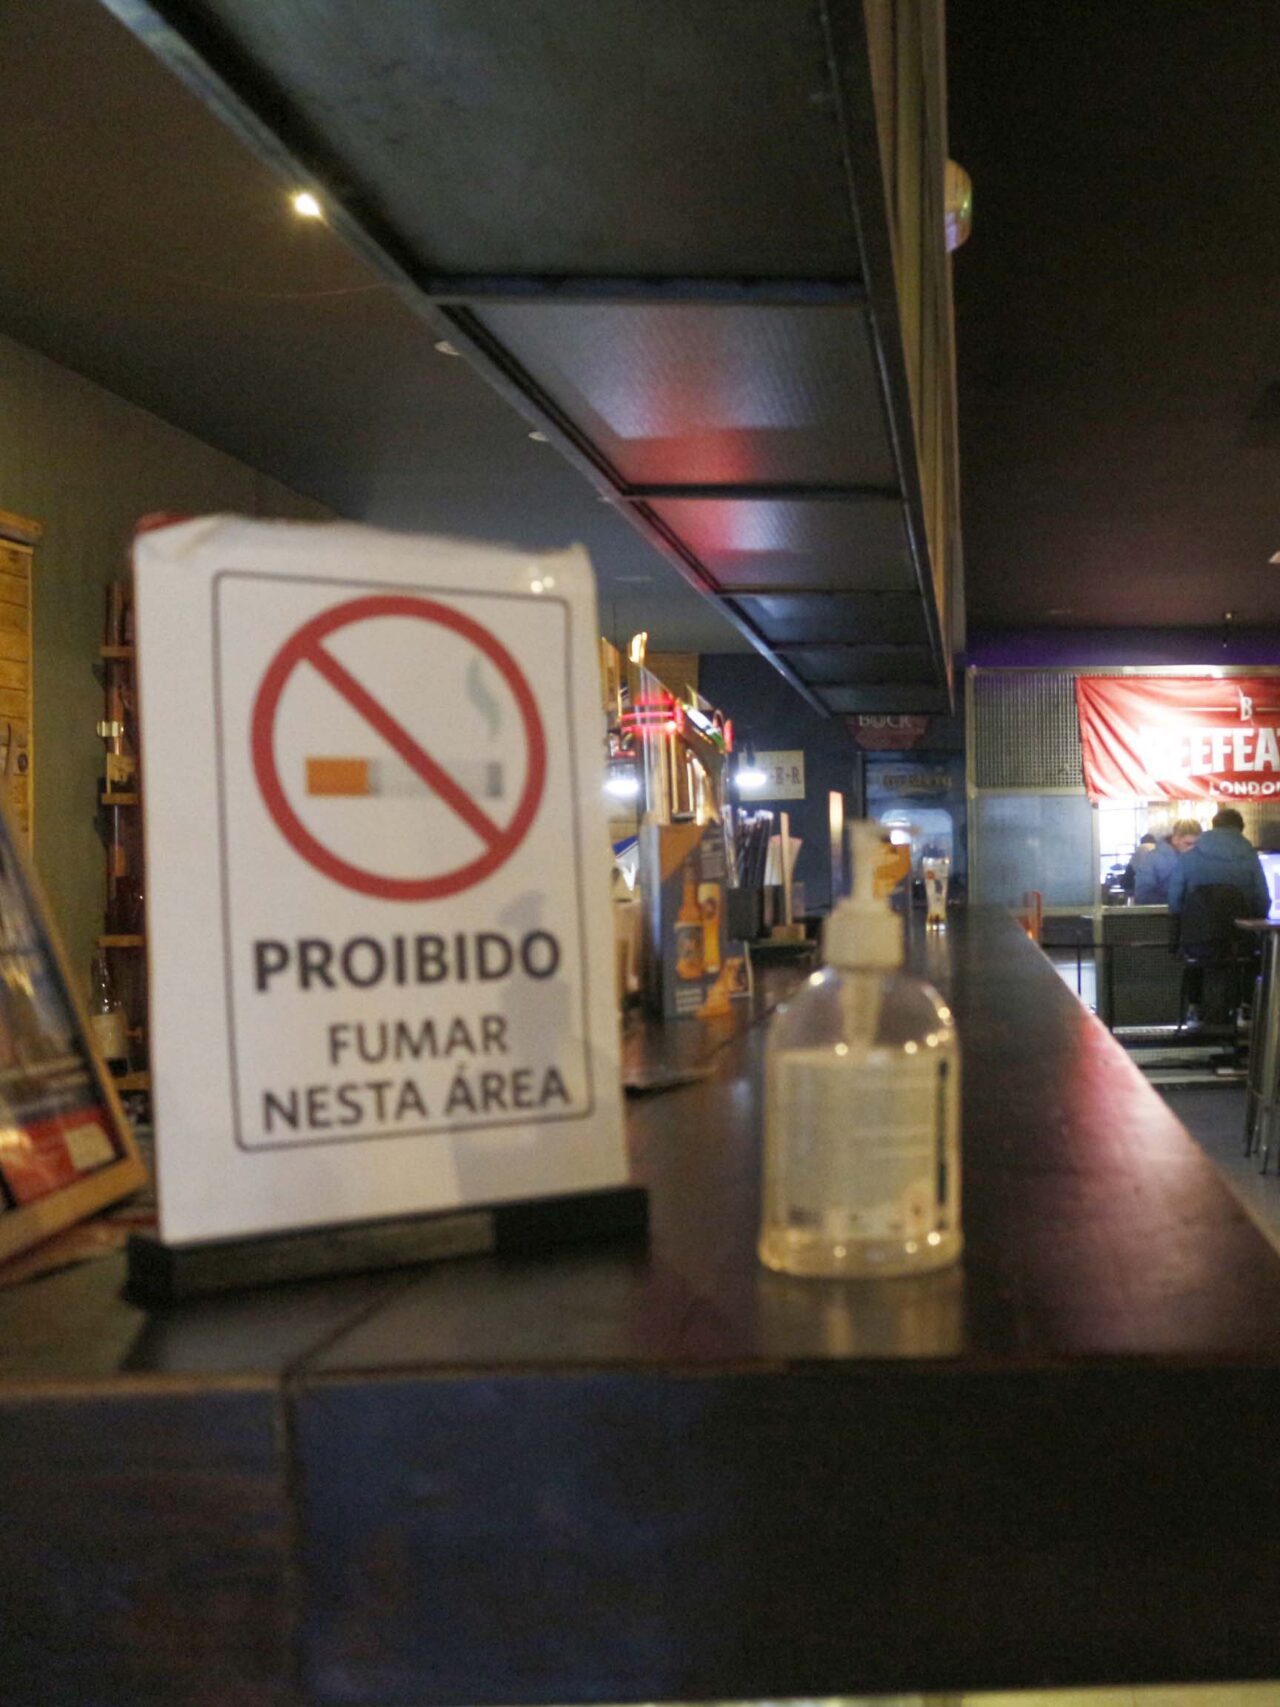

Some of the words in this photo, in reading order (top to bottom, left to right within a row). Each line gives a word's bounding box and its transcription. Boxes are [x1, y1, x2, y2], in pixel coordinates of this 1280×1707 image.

[254, 930, 560, 992] PROIBIDO
[328, 1014, 510, 1067] FUMAR
[262, 1082, 428, 1135] NESTA
[444, 1064, 573, 1117] ÁREA
